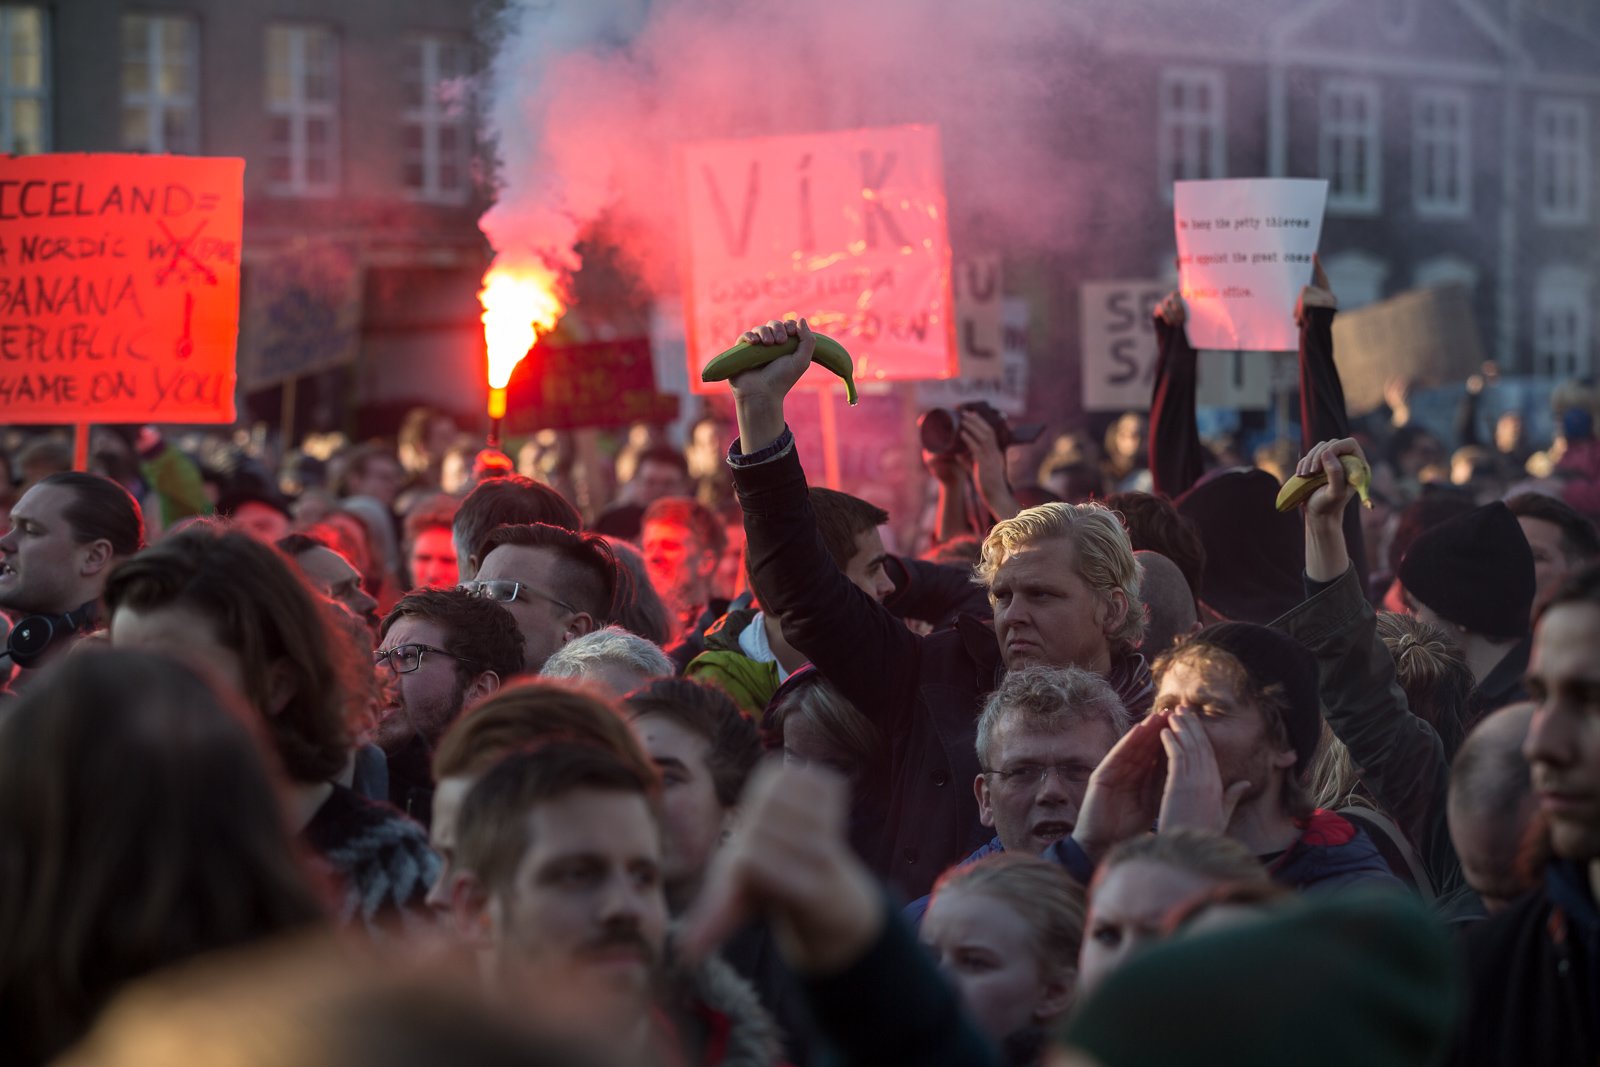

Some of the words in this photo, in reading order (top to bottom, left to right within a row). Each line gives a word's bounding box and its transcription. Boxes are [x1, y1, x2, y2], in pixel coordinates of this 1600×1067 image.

[1215, 216, 1230, 229] the
[1234, 217, 1260, 232] petty
[1265, 216, 1311, 229] thieves
[1232, 251, 1247, 264] the
